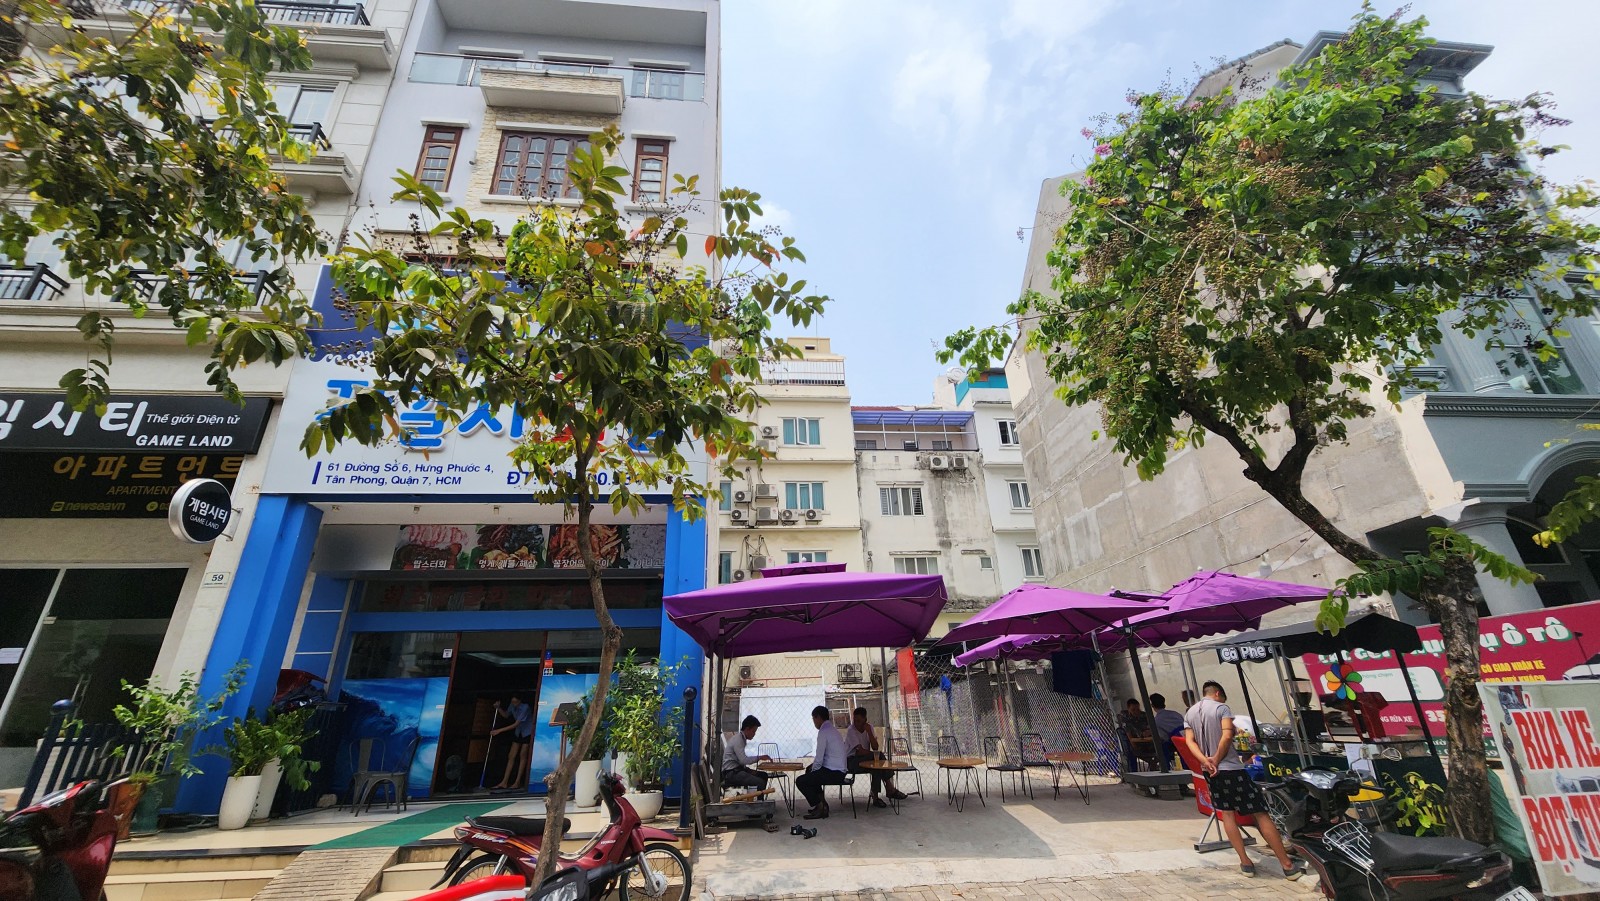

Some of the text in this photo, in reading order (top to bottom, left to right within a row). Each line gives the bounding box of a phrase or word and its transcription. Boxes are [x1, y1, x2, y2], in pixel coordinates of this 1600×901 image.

[147, 411, 241, 426] Thế giới Điện tử
[136, 435, 233, 447] GAME LAND
[53, 455, 244, 484] 아파트먼트
[327, 463, 340, 472] 61
[344, 461, 380, 474] Đường
[401, 463, 411, 473] 6,
[414, 463, 443, 474] Hưng
[447, 462, 481, 473] Phước
[484, 464, 494, 474] 4,
[325, 474, 462, 487] Tân Phong, Quận 7, HCM
[188, 497, 228, 524] 게임시티
[190, 514, 220, 530] GAME LAND
[211, 574, 224, 582] 59
[1534, 659, 1546, 670] XE
[1402, 715, 1415, 723] XE
